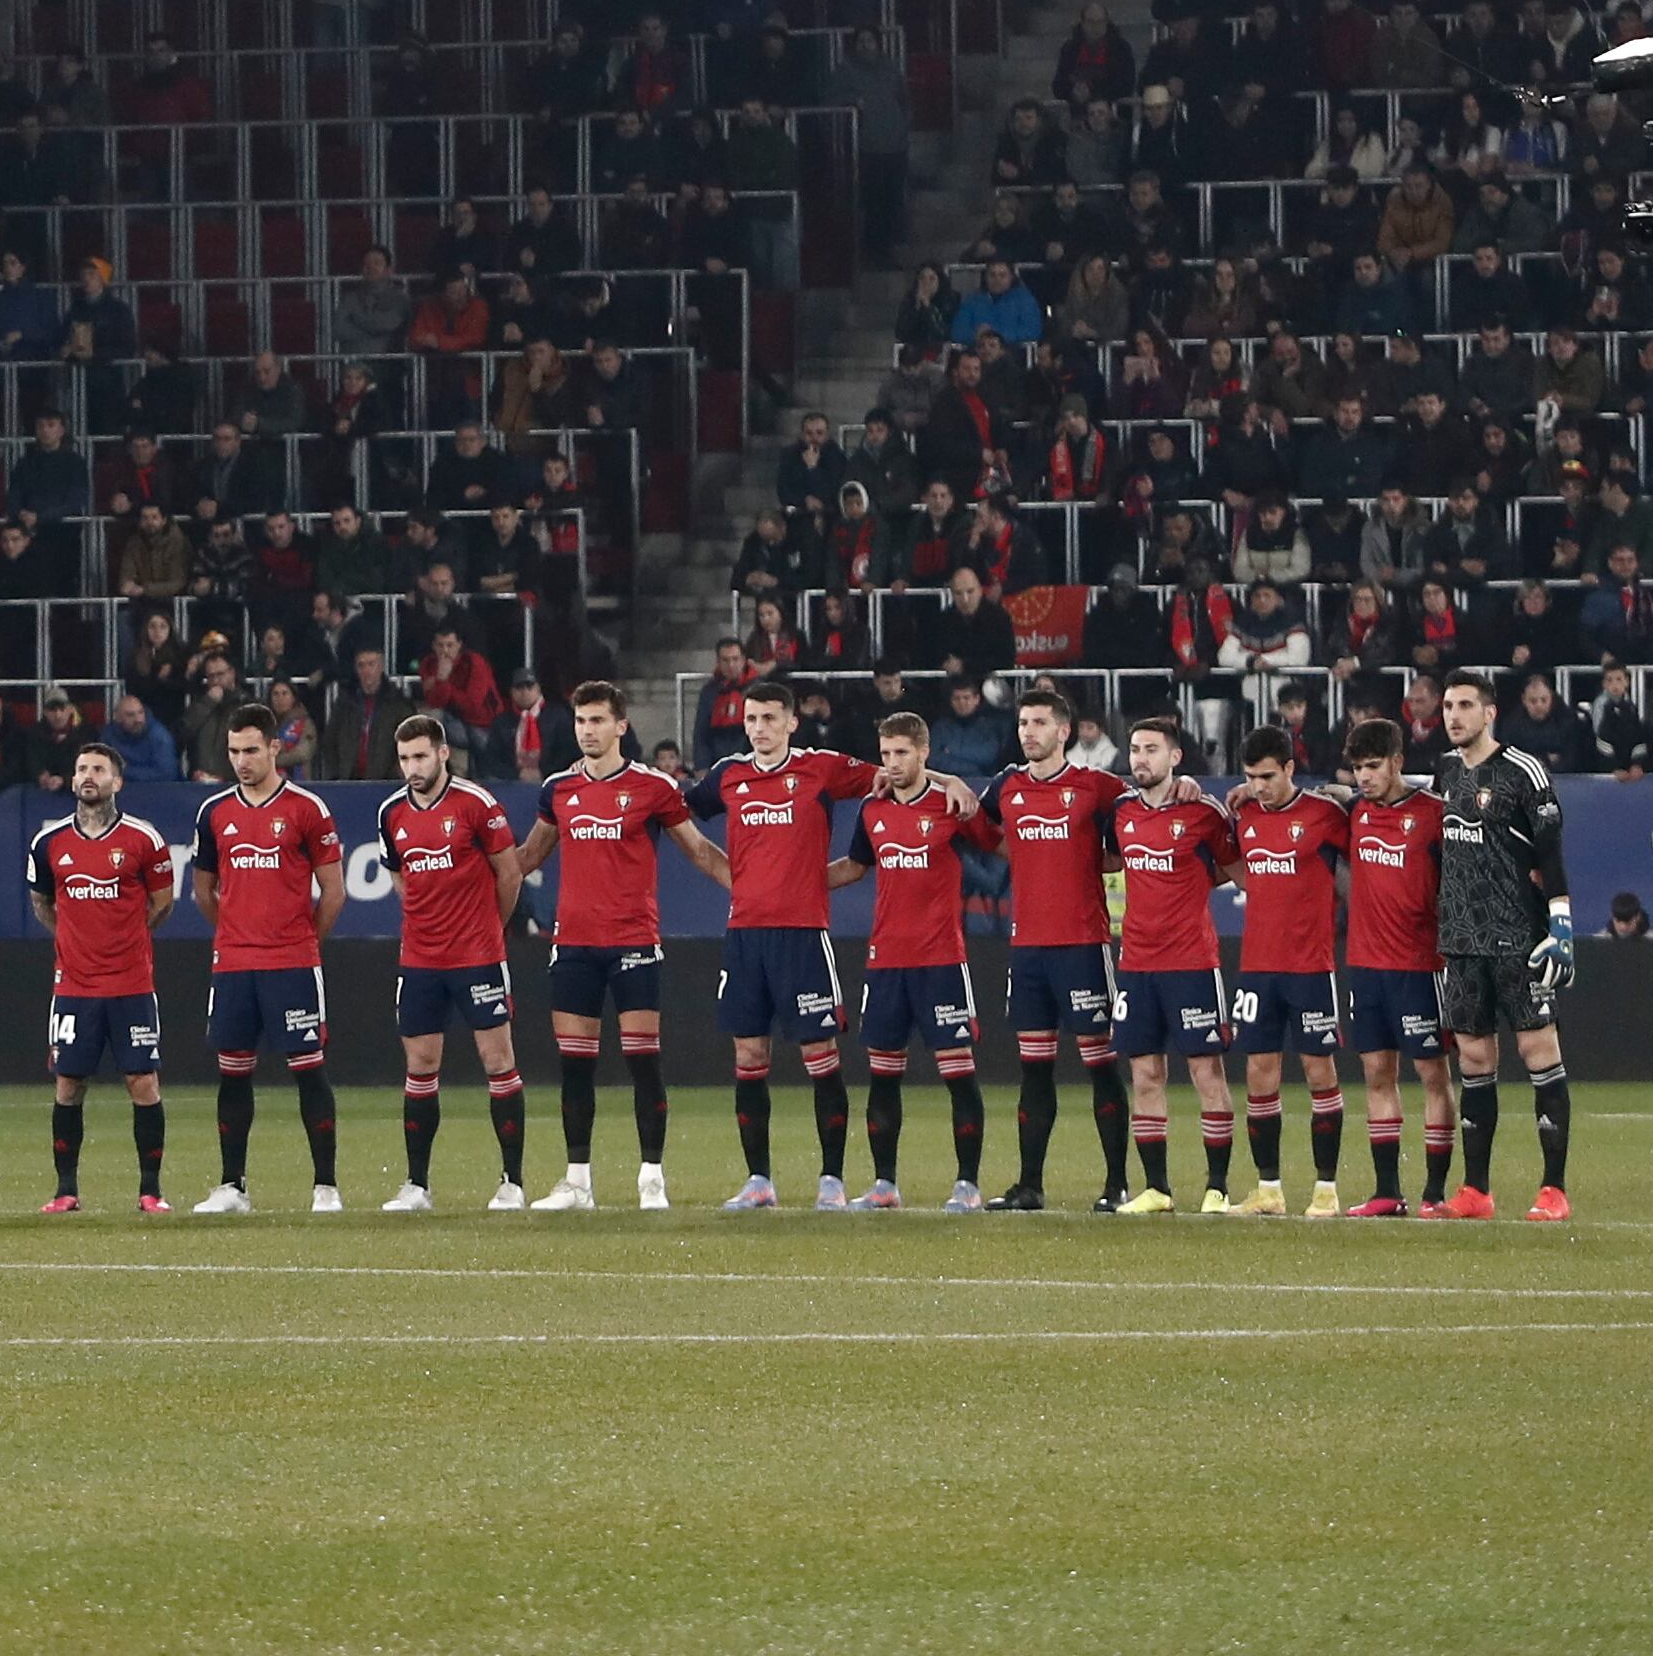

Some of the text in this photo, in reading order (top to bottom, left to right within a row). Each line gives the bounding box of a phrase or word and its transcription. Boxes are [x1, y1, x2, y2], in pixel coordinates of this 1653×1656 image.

[740, 807, 794, 826] verleal
[569, 824, 622, 841] verleal
[1017, 822, 1070, 840] verleal
[1443, 825, 1484, 844] verleal
[230, 852, 280, 869] verleal
[880, 852, 929, 869] verleal
[1124, 855, 1174, 873] verleal
[1247, 858, 1296, 875] verleal
[1358, 846, 1405, 869] verleal
[66, 883, 119, 900] verleal
[1232, 988, 1258, 1023] 20
[52, 1013, 77, 1045] 14
